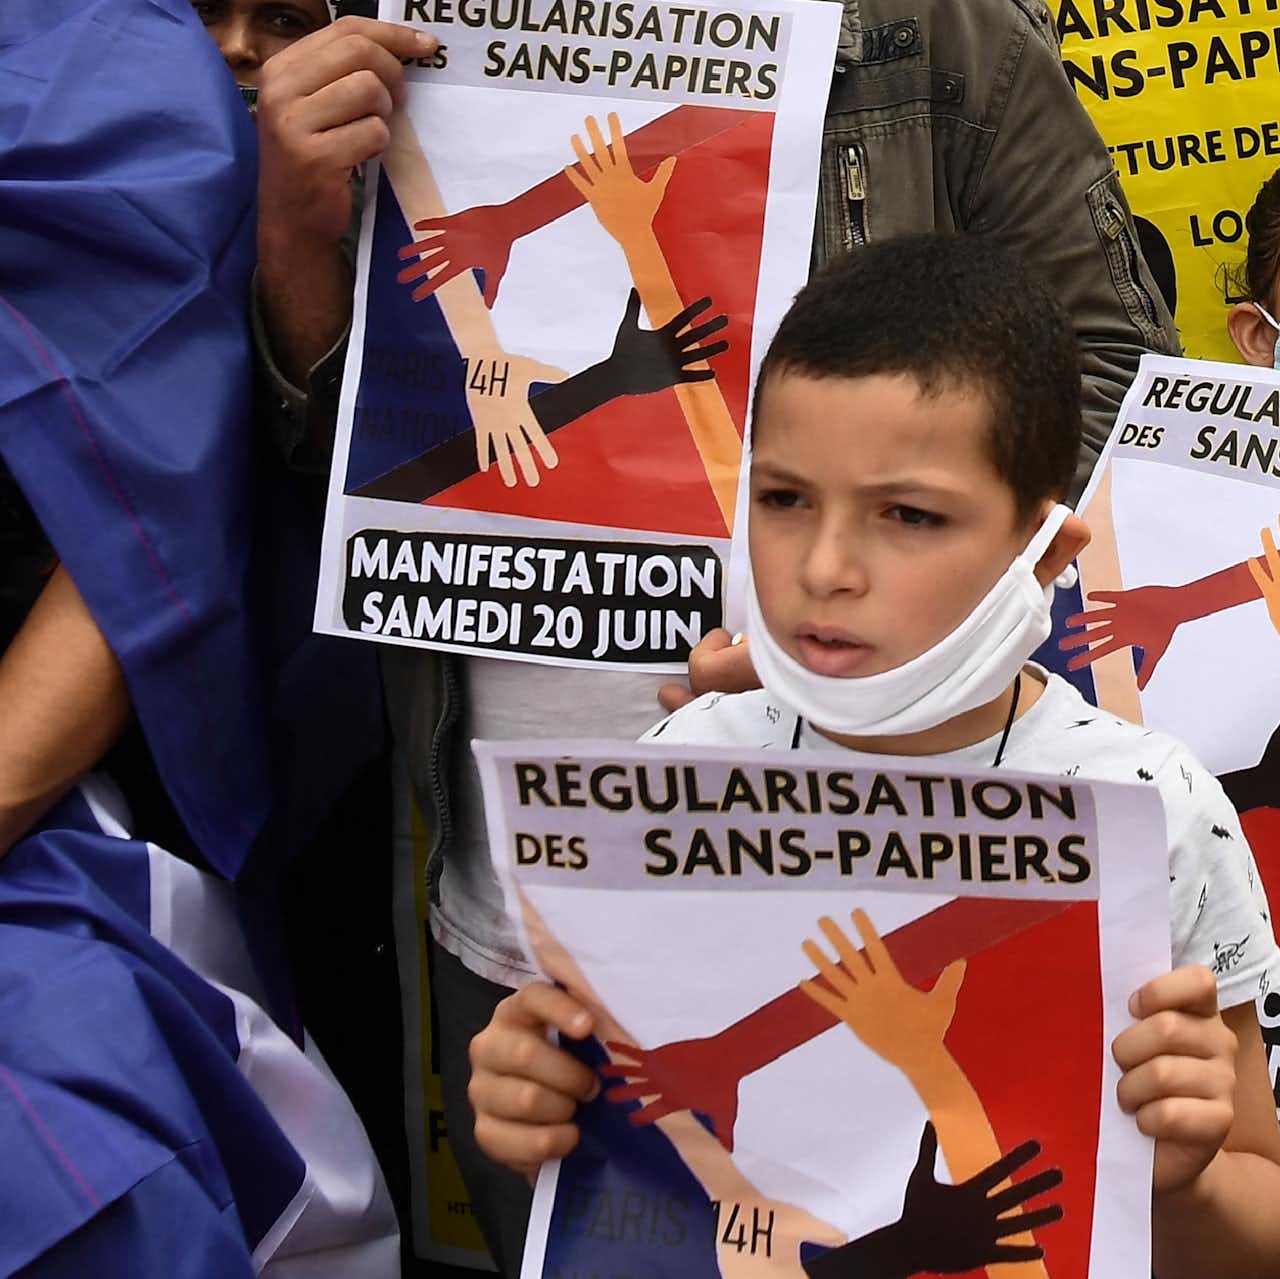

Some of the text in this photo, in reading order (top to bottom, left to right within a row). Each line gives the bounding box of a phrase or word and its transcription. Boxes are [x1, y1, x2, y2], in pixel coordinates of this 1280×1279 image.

[483, 40, 777, 100] SANS-PAPIERS
[1118, 423, 1164, 450] DES
[350, 536, 716, 598] MANIFESTATION
[361, 592, 702, 659] SAMEDI 20 JUIN
[513, 756, 1077, 821] RÉGULARISATION
[515, 827, 1093, 883] DES SANS-PAPIERS
